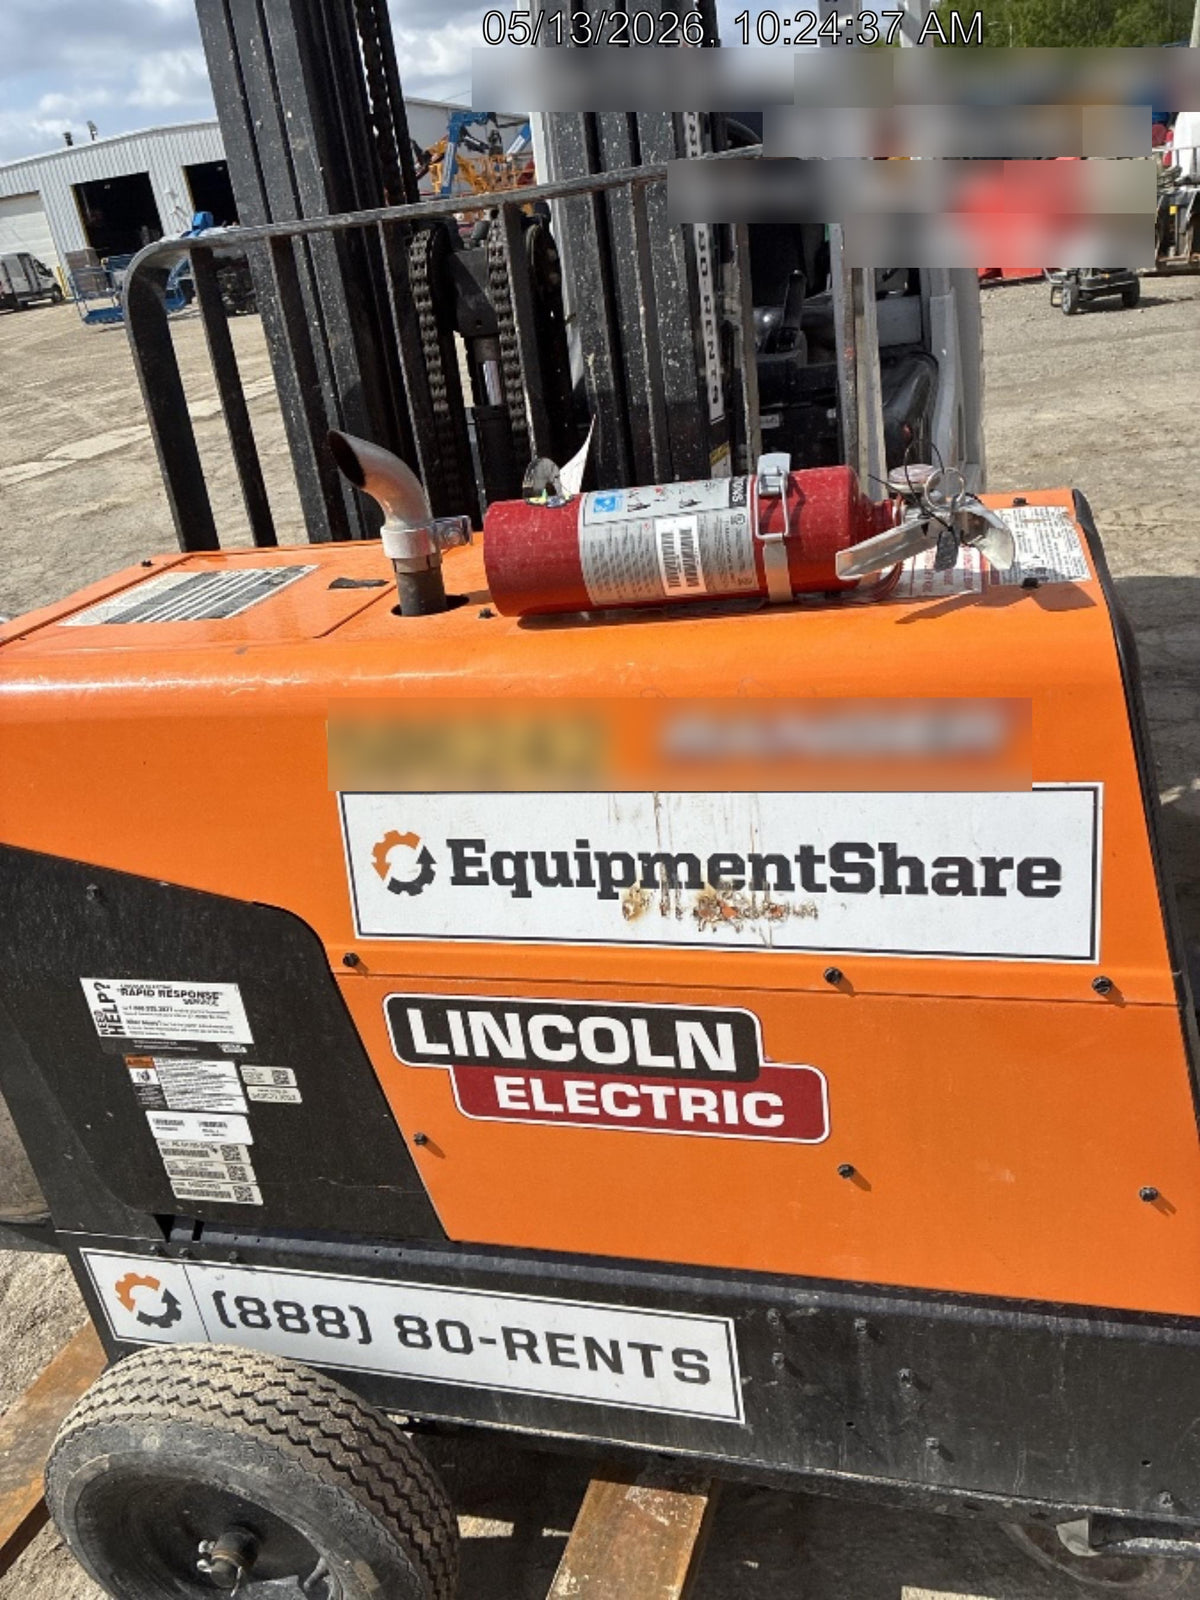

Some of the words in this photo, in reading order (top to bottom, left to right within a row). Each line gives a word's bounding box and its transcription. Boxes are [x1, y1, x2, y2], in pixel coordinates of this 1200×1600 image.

[445, 838, 1063, 900] EquipmentShare
[93, 981, 127, 1036] HELP?
[120, 986, 155, 998] RAPID
[157, 988, 221, 1000] RESPONSE
[93, 1010, 109, 1036] NEED
[406, 1007, 737, 1073] LINCOLN
[493, 1075, 785, 1128] ELECTRIC
[211, 1289, 372, 1346] (888)
[394, 1314, 711, 1387] 80-RENTS
